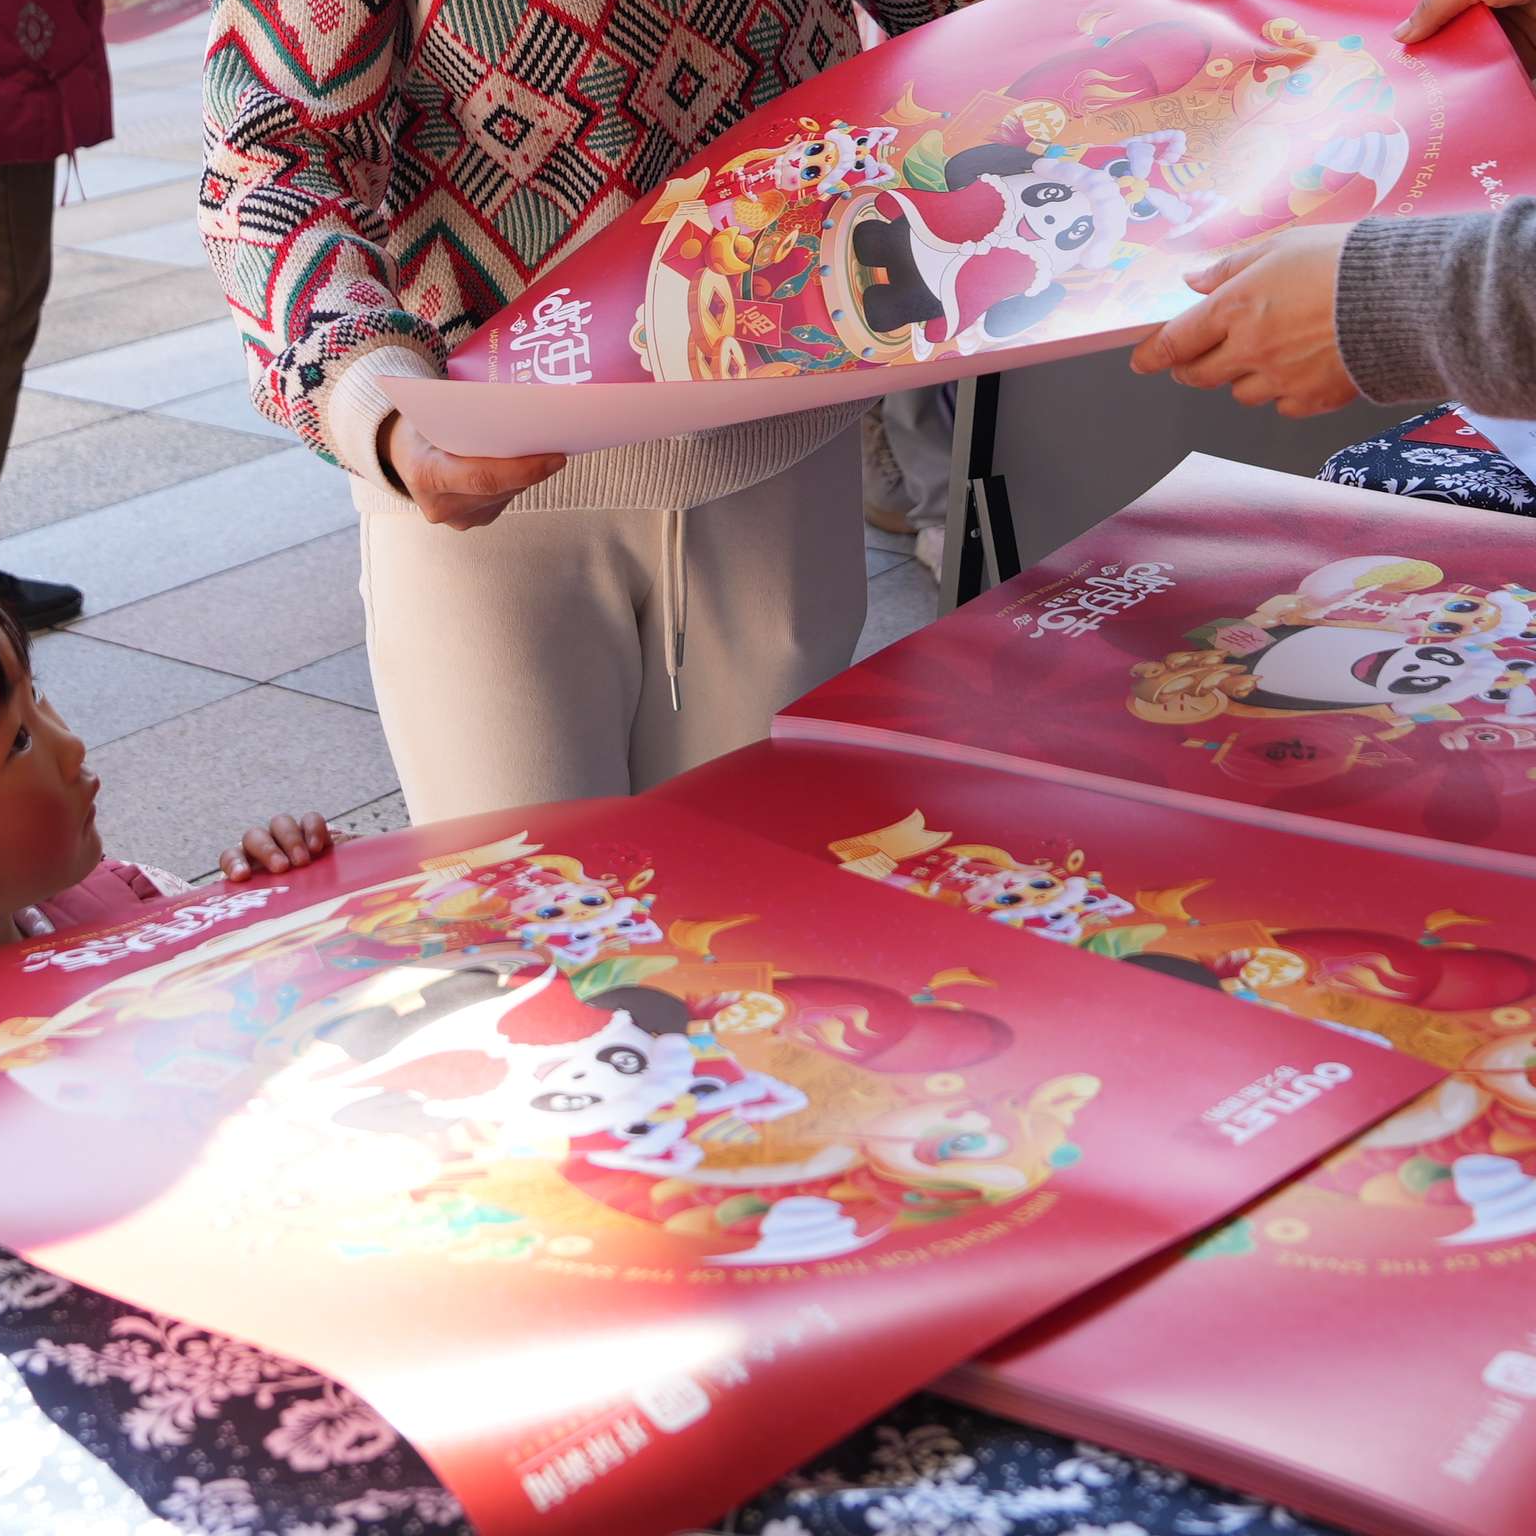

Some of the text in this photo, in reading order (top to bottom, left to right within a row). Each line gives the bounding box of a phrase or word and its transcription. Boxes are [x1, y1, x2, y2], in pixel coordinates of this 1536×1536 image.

[1423, 132, 1444, 160] THE
[1406, 163, 1436, 199] YEAR
[1219, 1062, 1353, 1146] OUTLET
